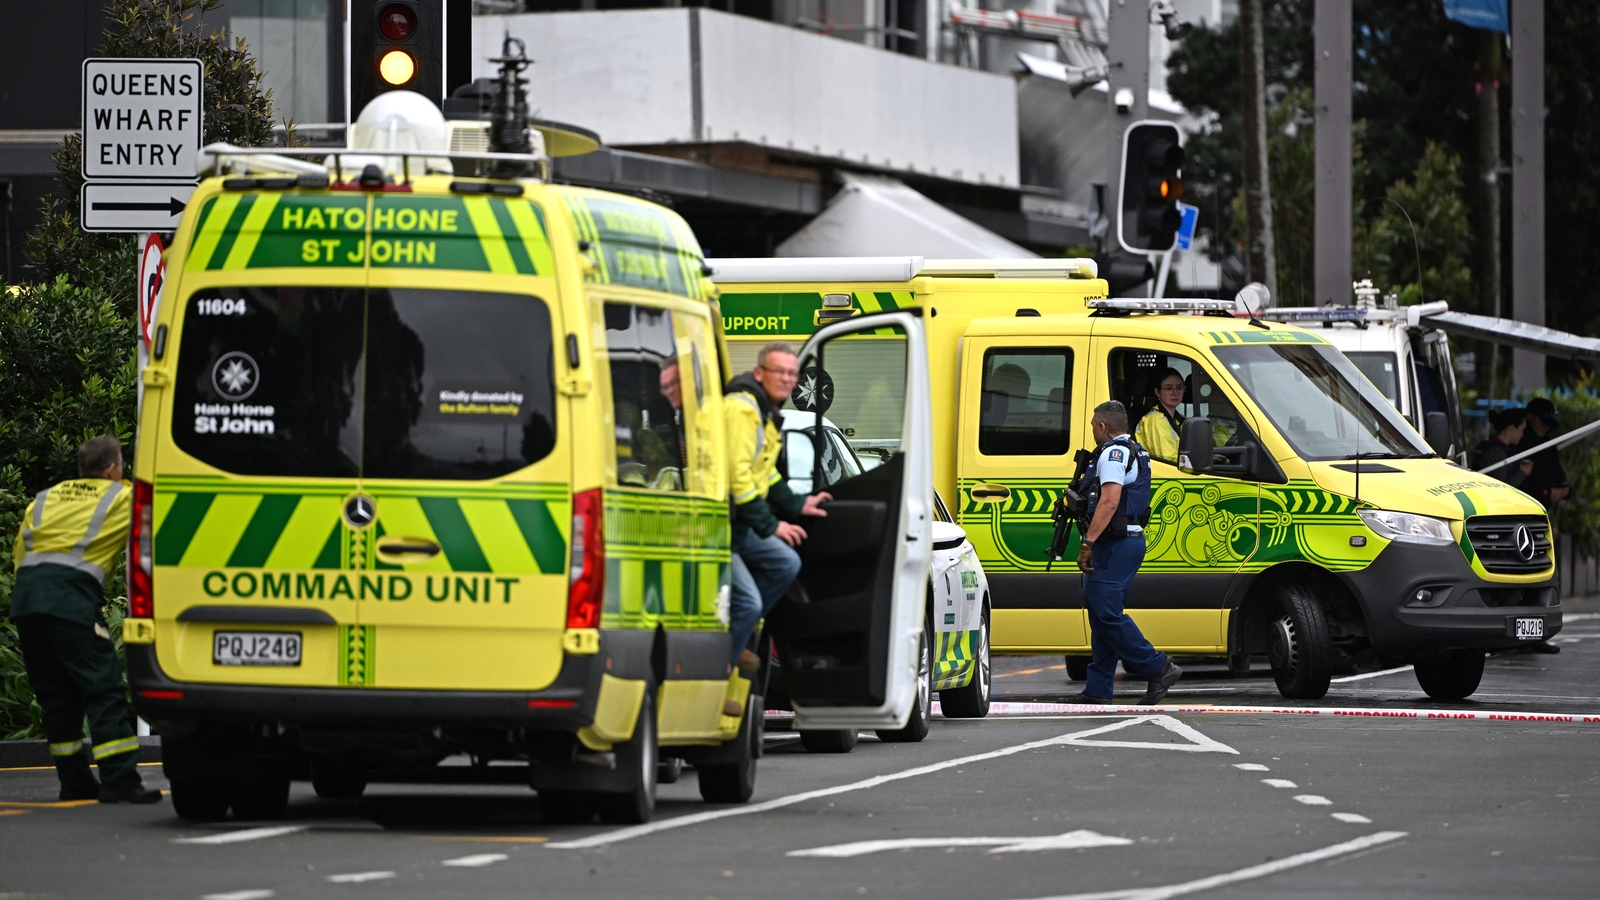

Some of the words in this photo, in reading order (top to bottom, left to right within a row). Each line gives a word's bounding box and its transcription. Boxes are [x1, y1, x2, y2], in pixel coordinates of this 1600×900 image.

[93, 74, 193, 96] QUEENS
[94, 108, 192, 131] WHARF
[100, 143, 183, 166] ENTRY
[282, 207, 366, 230] HATO
[373, 207, 459, 232] HONE
[301, 239, 341, 263] ST
[347, 239, 436, 264] JOHN
[197, 298, 247, 315] 11604
[722, 316, 790, 331] UPPORT
[439, 389, 470, 403] Kindly
[470, 390, 510, 403] donated
[511, 390, 524, 405] by
[194, 402, 231, 416] Hato
[232, 403, 275, 417] Hone
[439, 402, 456, 414] the
[489, 403, 519, 417] family
[194, 416, 218, 434] St
[219, 416, 275, 435] John
[203, 571, 413, 601] COMMAND
[426, 575, 520, 604] UNIT
[1516, 620, 1543, 635] PQJ219
[217, 636, 298, 658] PQJ240
